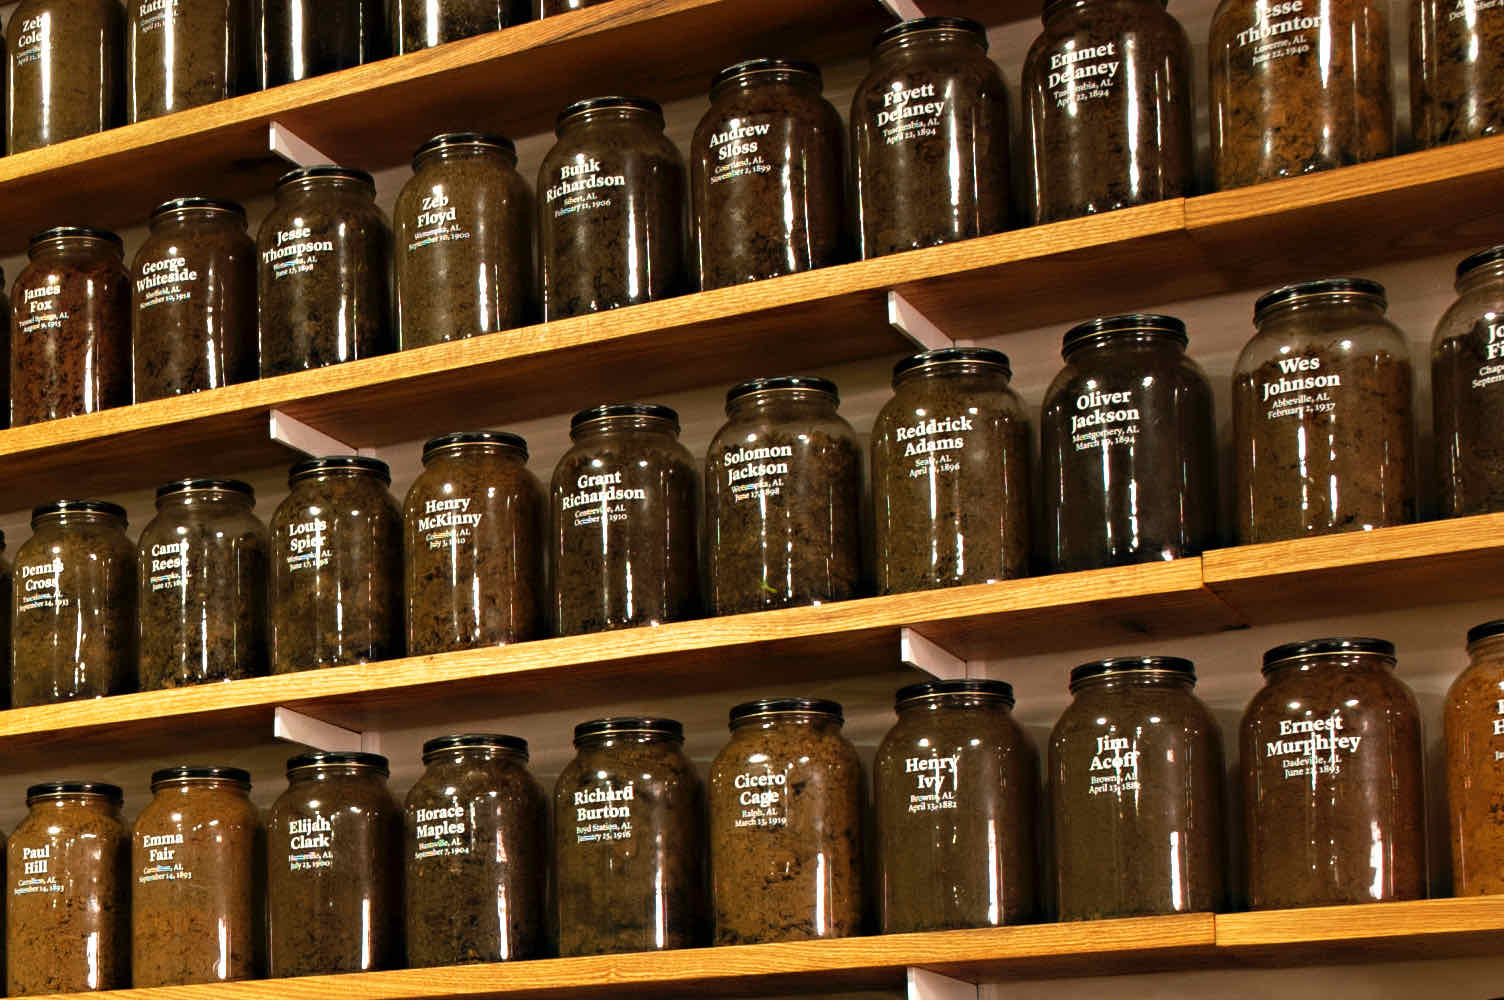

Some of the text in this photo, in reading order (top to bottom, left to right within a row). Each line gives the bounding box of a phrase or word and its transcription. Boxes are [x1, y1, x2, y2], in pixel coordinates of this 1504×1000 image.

[709, 122, 770, 148] Andrew
[718, 140, 758, 160] Sloss
[277, 225, 311, 246] Jesse
[263, 239, 333, 265] Thompson
[142, 256, 186, 276] George
[137, 269, 197, 293] Whiteside
[1279, 357, 1320, 374] Wes
[1263, 371, 1341, 401] Johnson
[1076, 390, 1132, 411] Oliver
[896, 416, 973, 441] Reddrick
[1071, 406, 1140, 434] Jackson
[724, 444, 792, 467] Solomon
[904, 435, 964, 457] Adams
[727, 460, 788, 485] Jackson
[425, 497, 471, 515] Henry
[419, 511, 482, 532] McKinny
[1279, 714, 1343, 737] Ernest
[734, 772, 786, 790] Cicero
[574, 786, 634, 806] Richard
[739, 788, 779, 808] Cage
[416, 804, 464, 822] Horace
[576, 804, 630, 822] Burton
[143, 833, 184, 848] Emma
[416, 820, 465, 841] Maples
[149, 847, 175, 862] Fair
